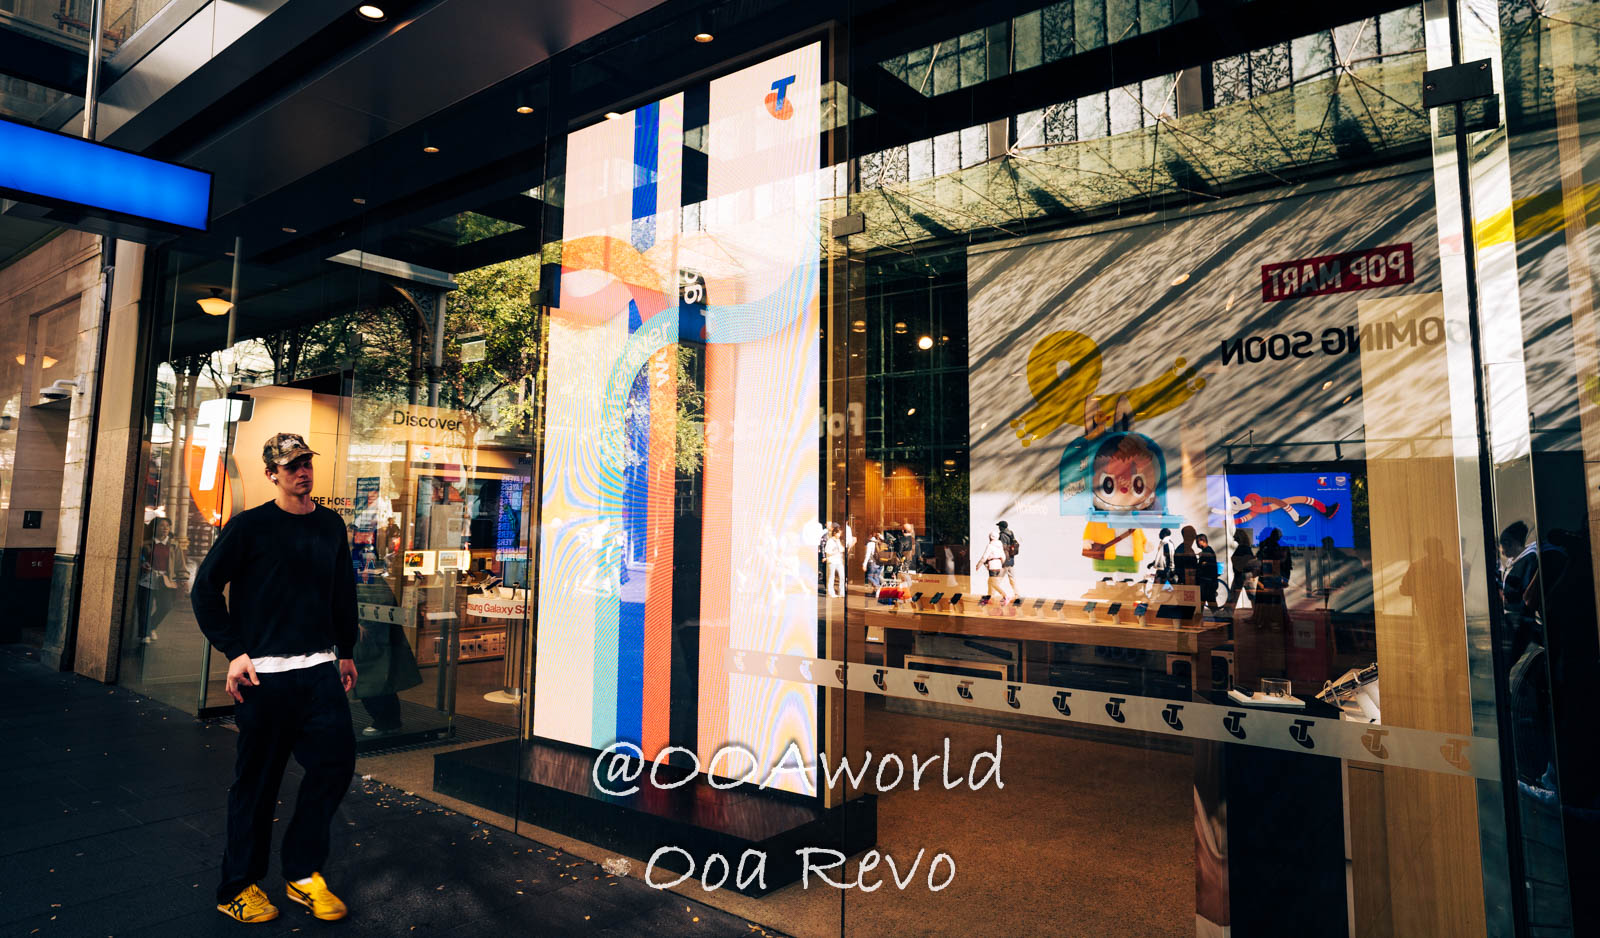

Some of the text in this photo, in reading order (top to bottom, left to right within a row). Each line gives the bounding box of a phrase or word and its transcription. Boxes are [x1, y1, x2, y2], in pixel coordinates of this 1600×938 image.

[393, 410, 462, 431] Discover
[327, 497, 351, 507] HOSE
[484, 603, 513, 615] Galaxy
